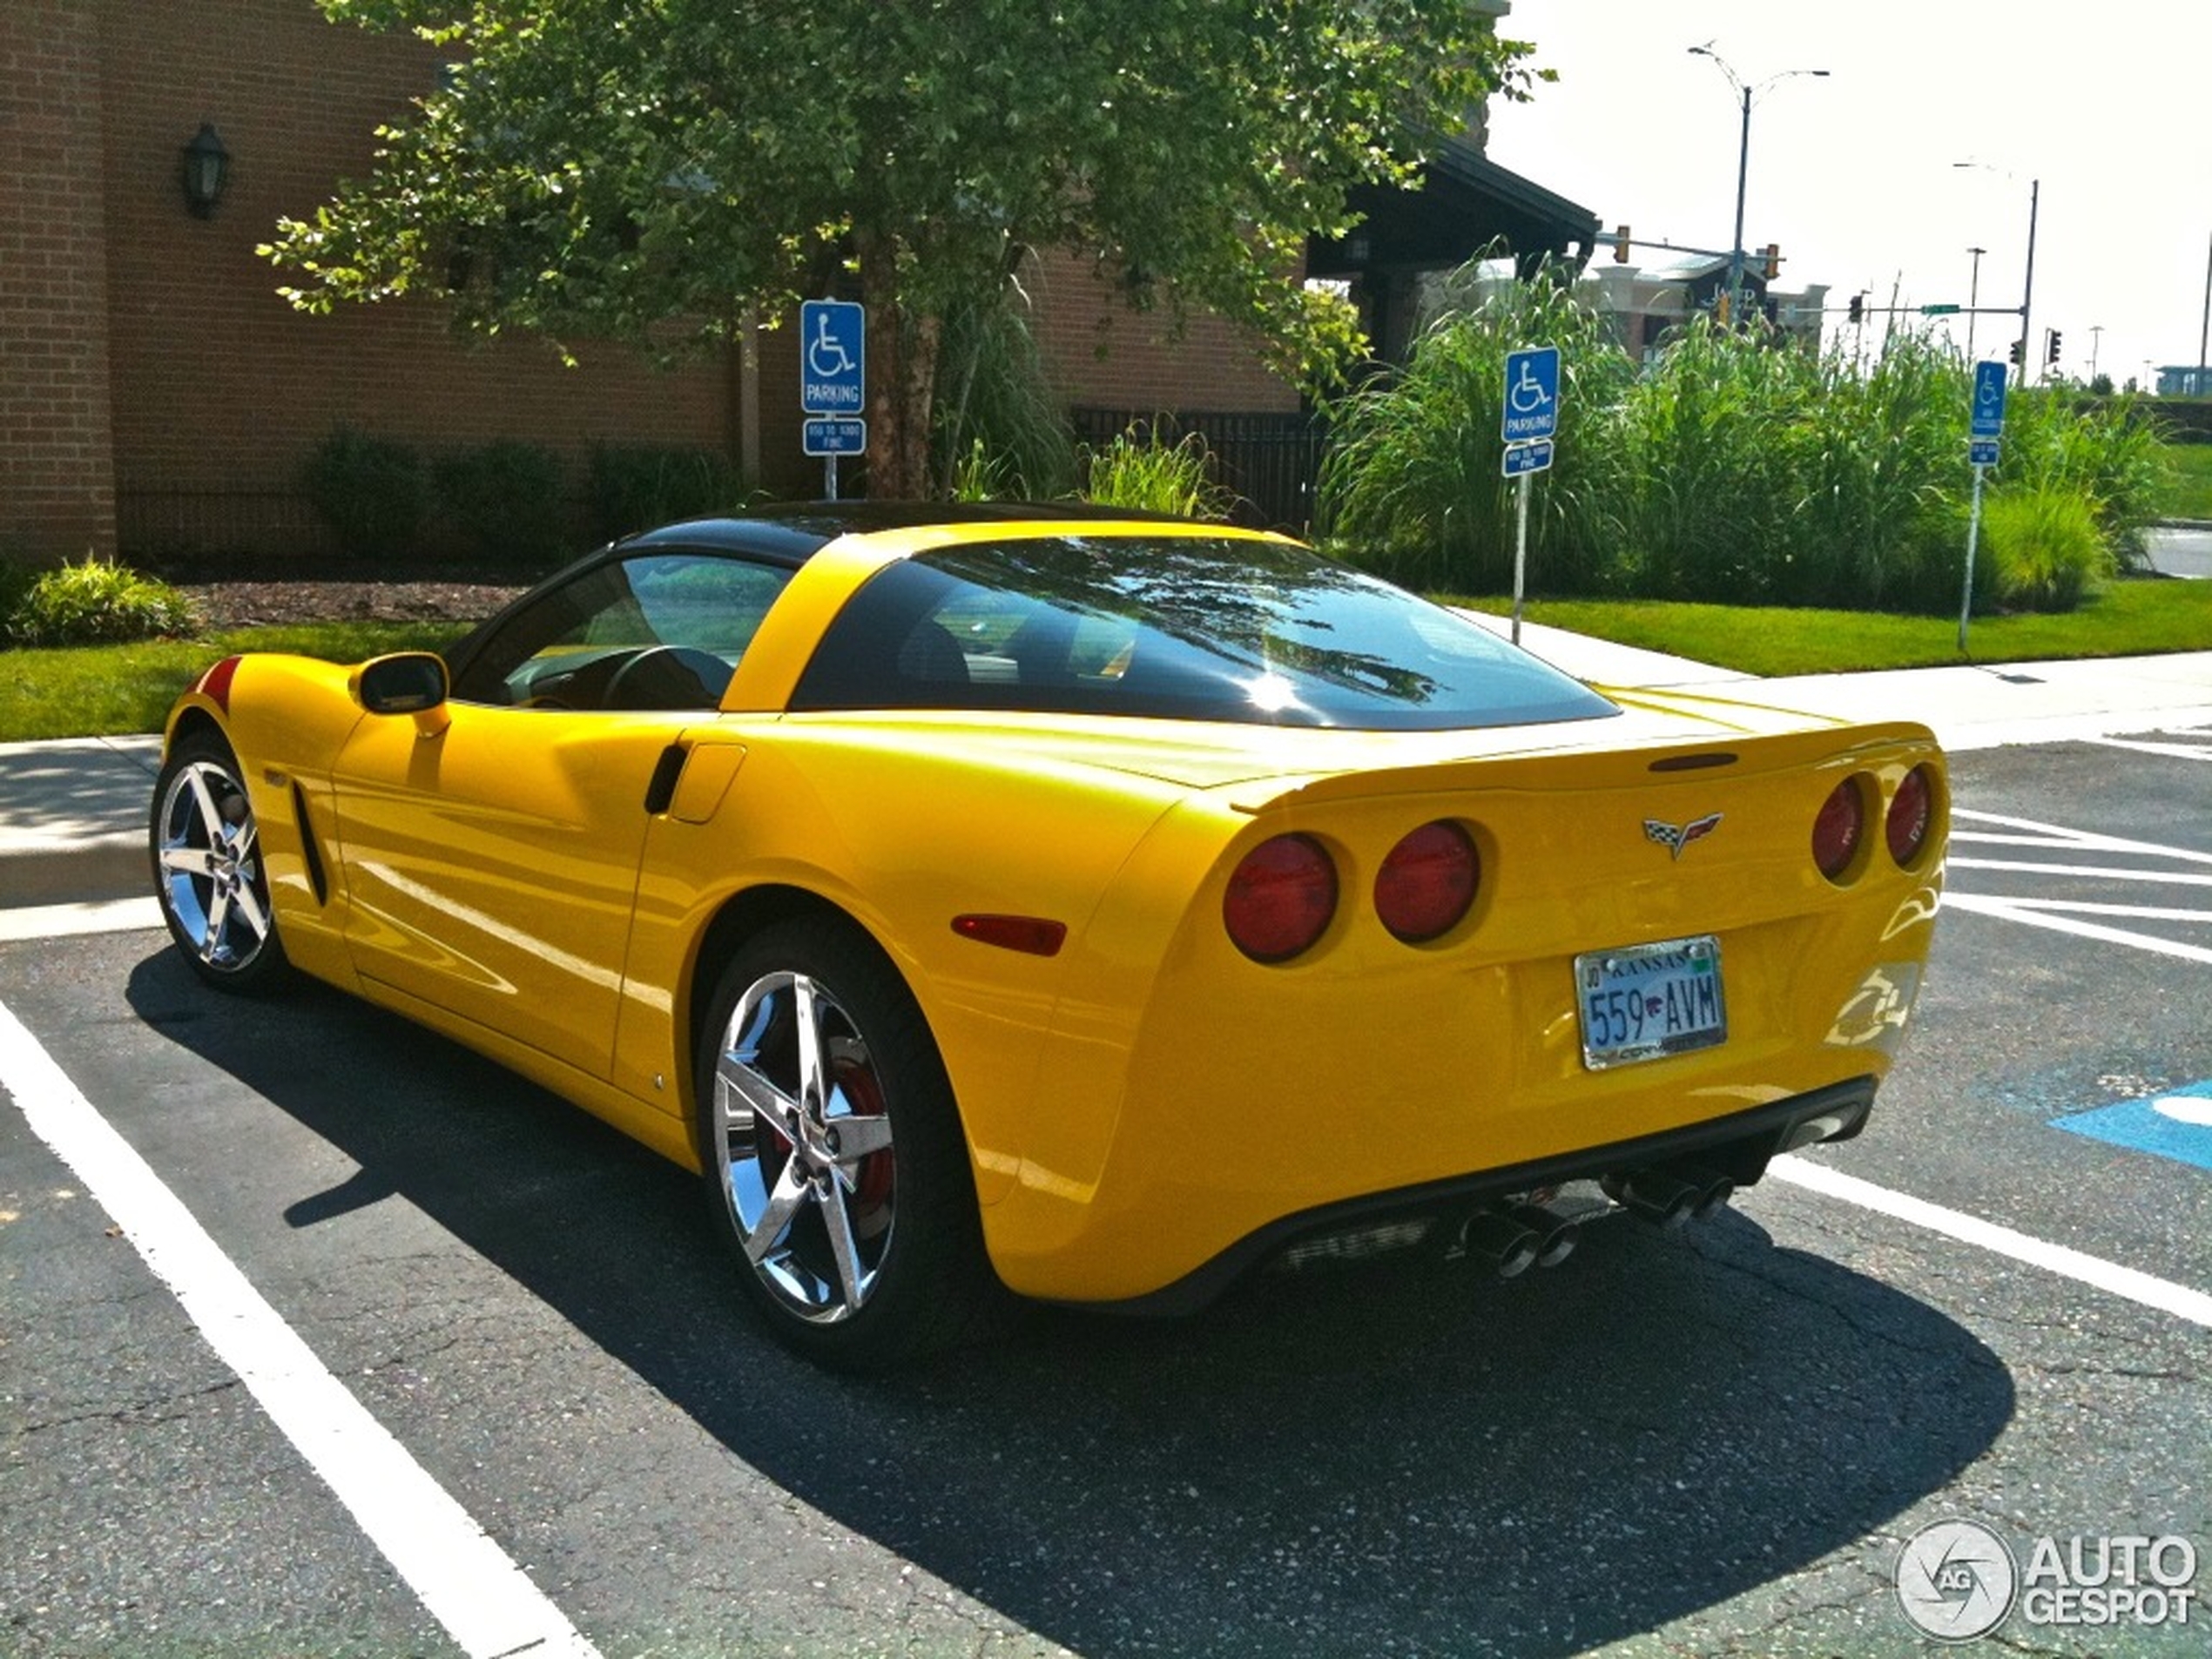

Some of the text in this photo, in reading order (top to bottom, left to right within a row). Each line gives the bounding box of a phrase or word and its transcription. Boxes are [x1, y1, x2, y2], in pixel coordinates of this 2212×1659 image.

[806, 384, 859, 402] PARKING
[1507, 415, 1552, 434] PARKING
[1589, 975, 1717, 1046] 559 AVM
